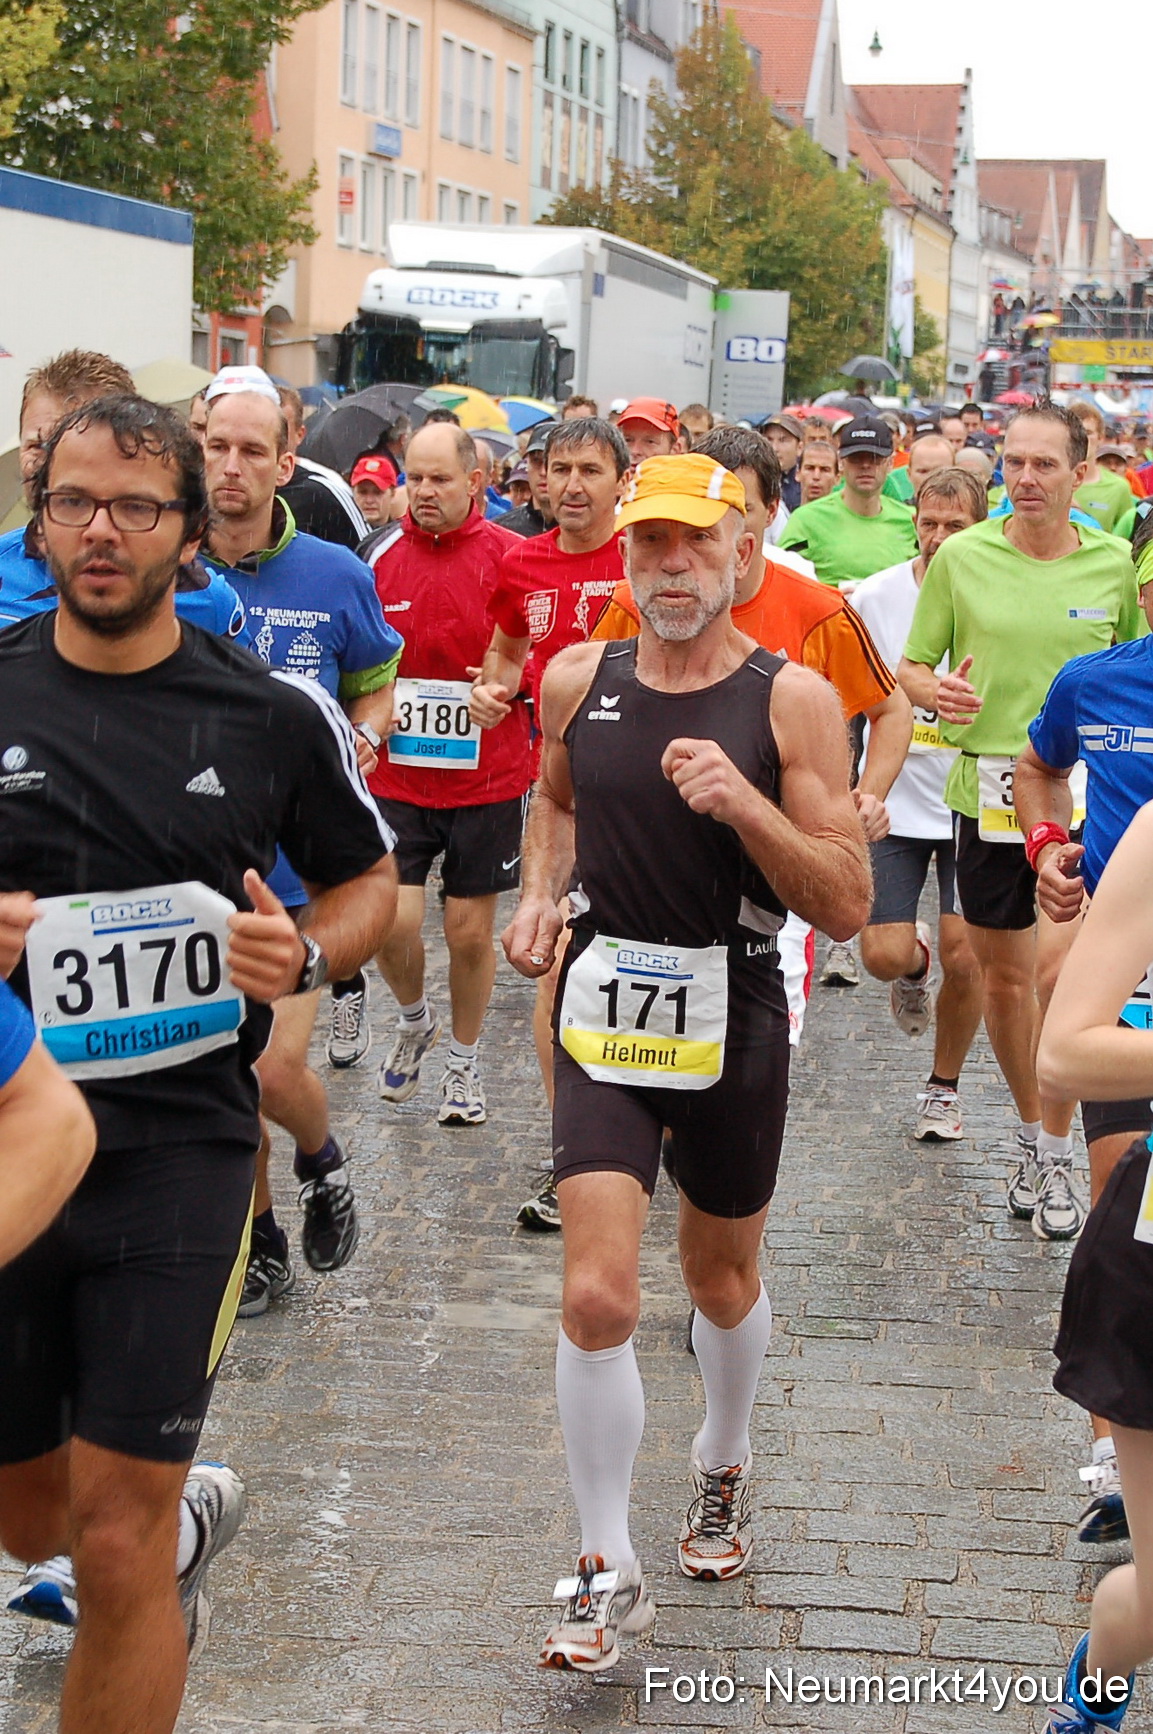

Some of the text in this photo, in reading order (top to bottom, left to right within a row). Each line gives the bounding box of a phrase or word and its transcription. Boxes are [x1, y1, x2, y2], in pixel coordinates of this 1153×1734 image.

[407, 286, 499, 319] BOCK
[264, 616, 318, 629] STADTLAUF
[266, 608, 331, 623] NEUMARKTER
[397, 701, 472, 737] 3180
[587, 709, 621, 721] erima
[413, 742, 448, 755] Josef
[92, 898, 173, 924] BOCK
[617, 950, 679, 970] BOCK
[53, 931, 221, 1016] 3170
[599, 978, 688, 1035] 171
[85, 1020, 200, 1056] Christian
[602, 1041, 677, 1067] Helmut
